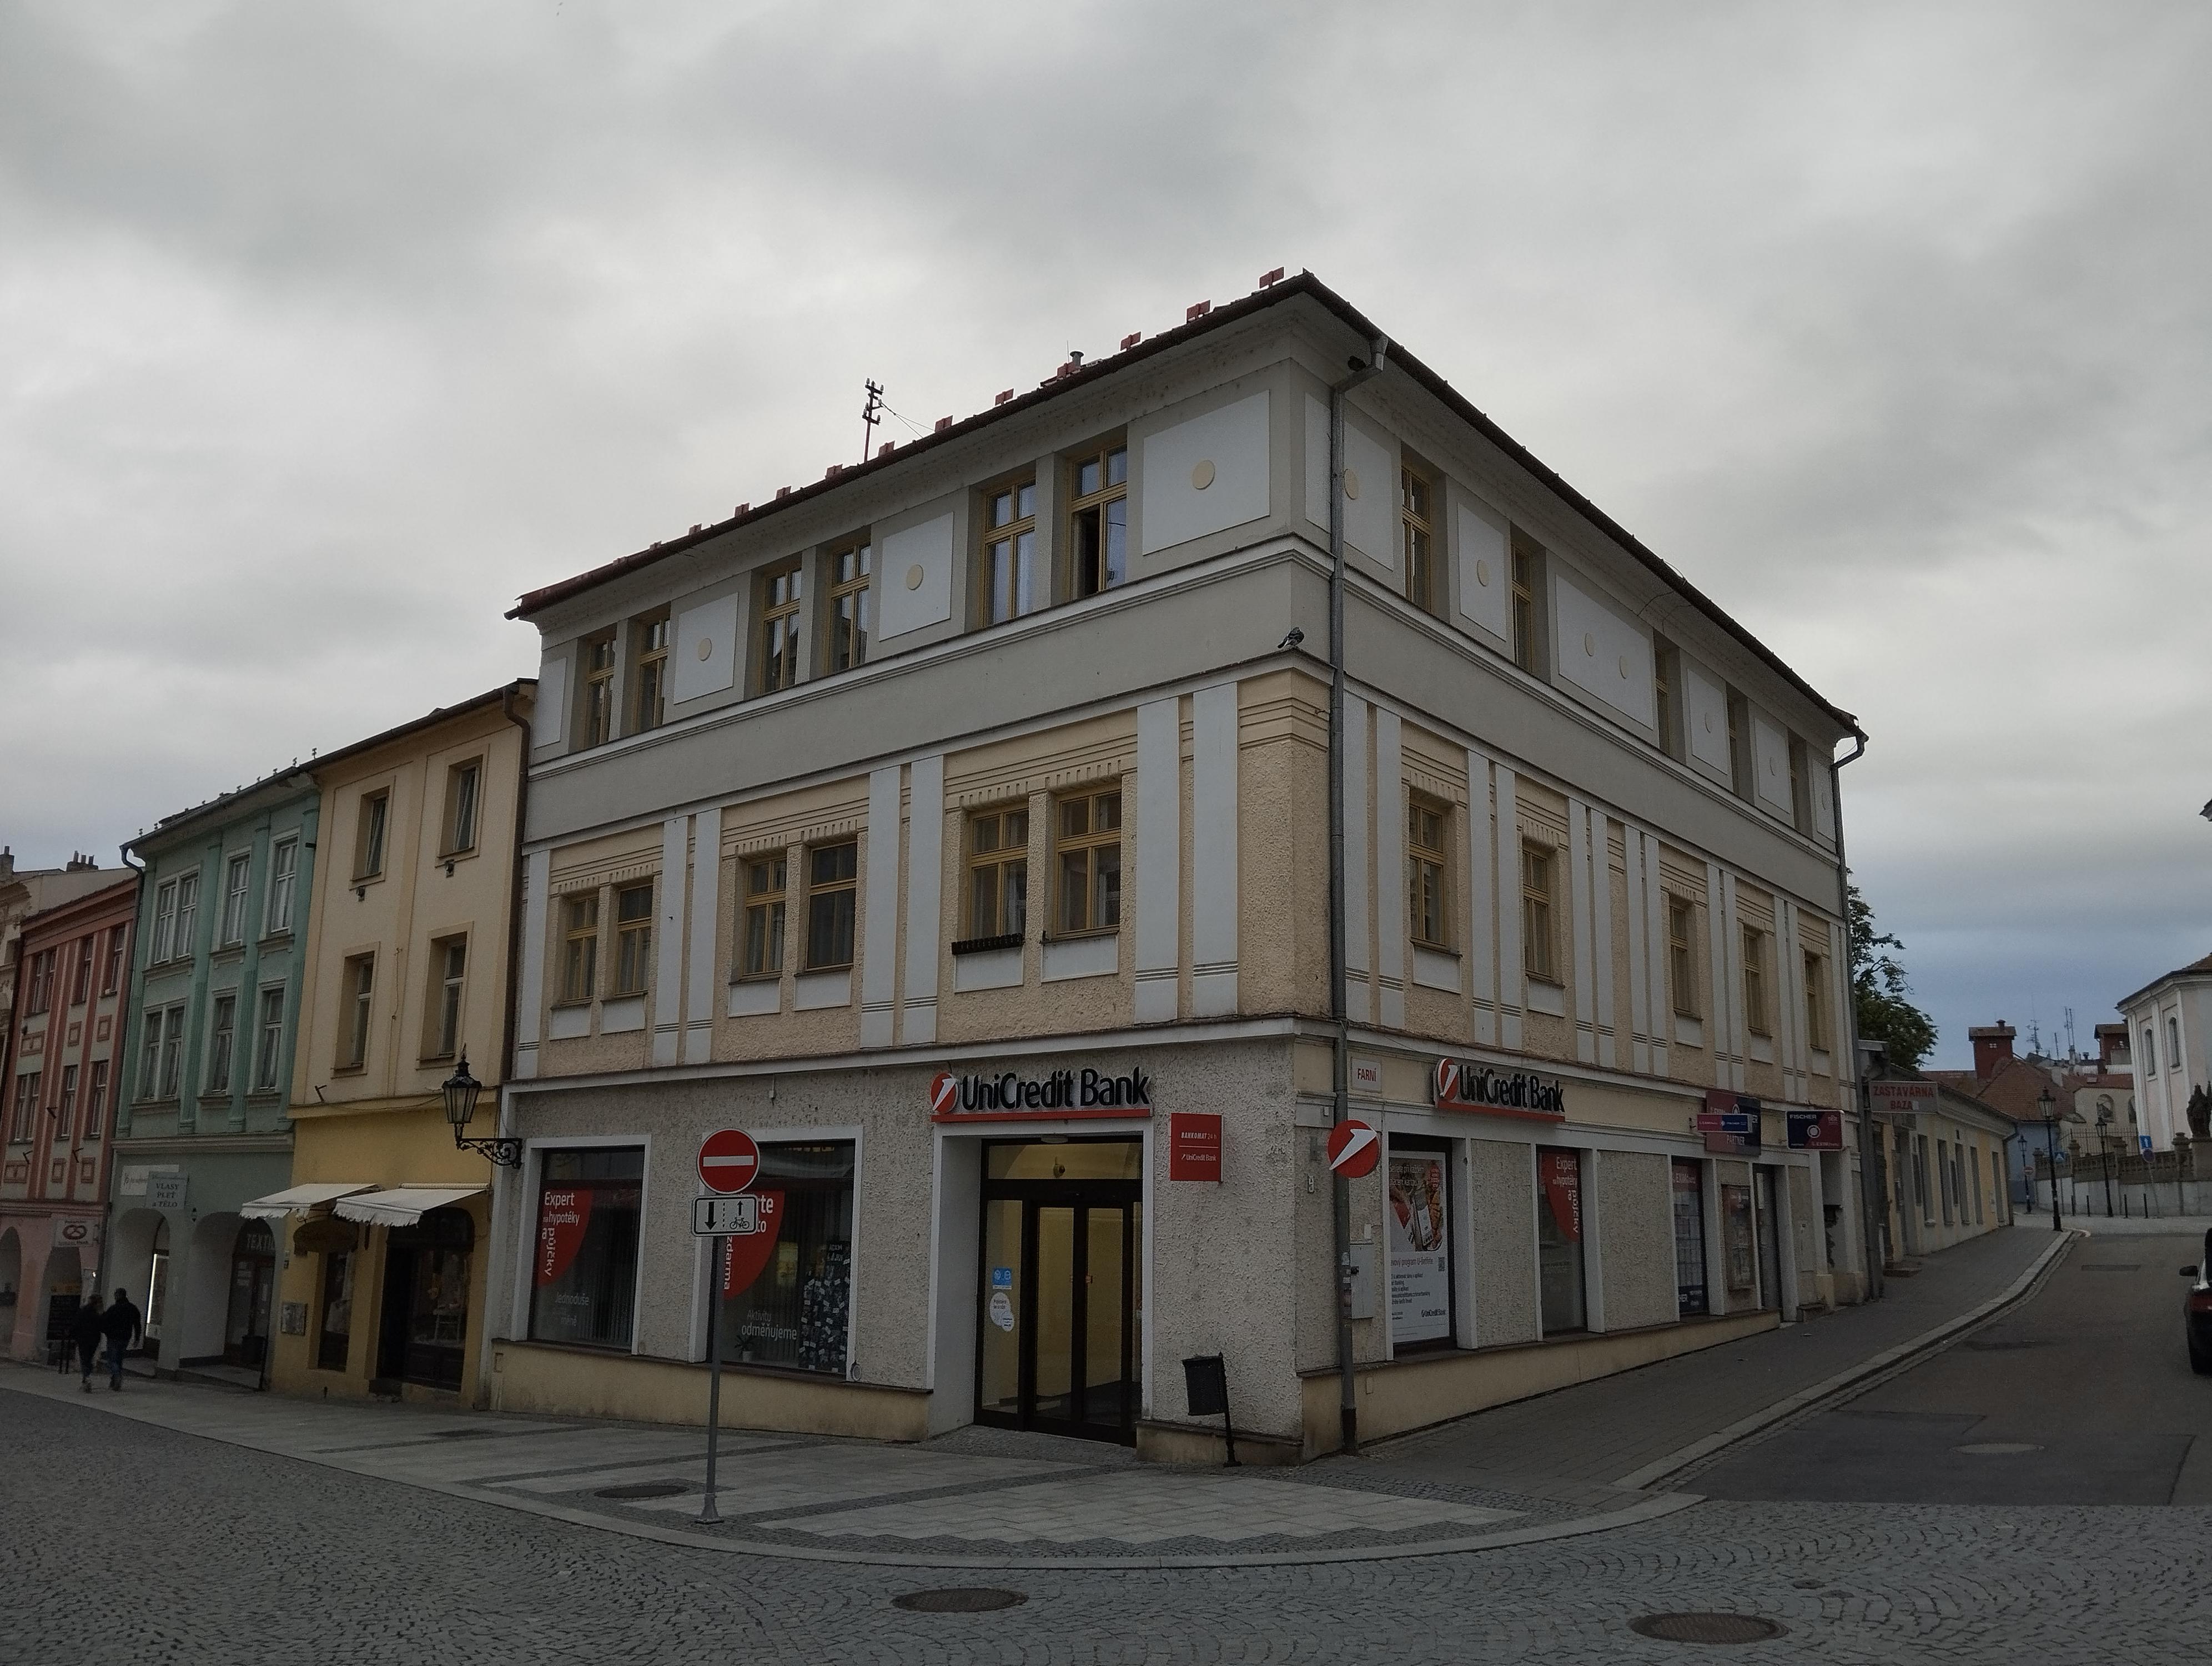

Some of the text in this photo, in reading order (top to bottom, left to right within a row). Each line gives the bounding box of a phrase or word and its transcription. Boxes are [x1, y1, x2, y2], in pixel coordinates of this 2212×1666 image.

[1358, 1067, 1376, 1082] FARNÍ
[962, 1066, 1150, 1110] UniCredit Bank
[1459, 1065, 1565, 1112] UniCredit Bank
[1556, 1156, 1577, 1172] Expert
[545, 1192, 575, 1209] Expert
[549, 1211, 580, 1226] hypotéky
[542, 1228, 556, 1277] a půjčky
[723, 1236, 733, 1289] zdarma
[555, 1292, 590, 1306] Jednoduše
[741, 1322, 797, 1342] odměňujeme
